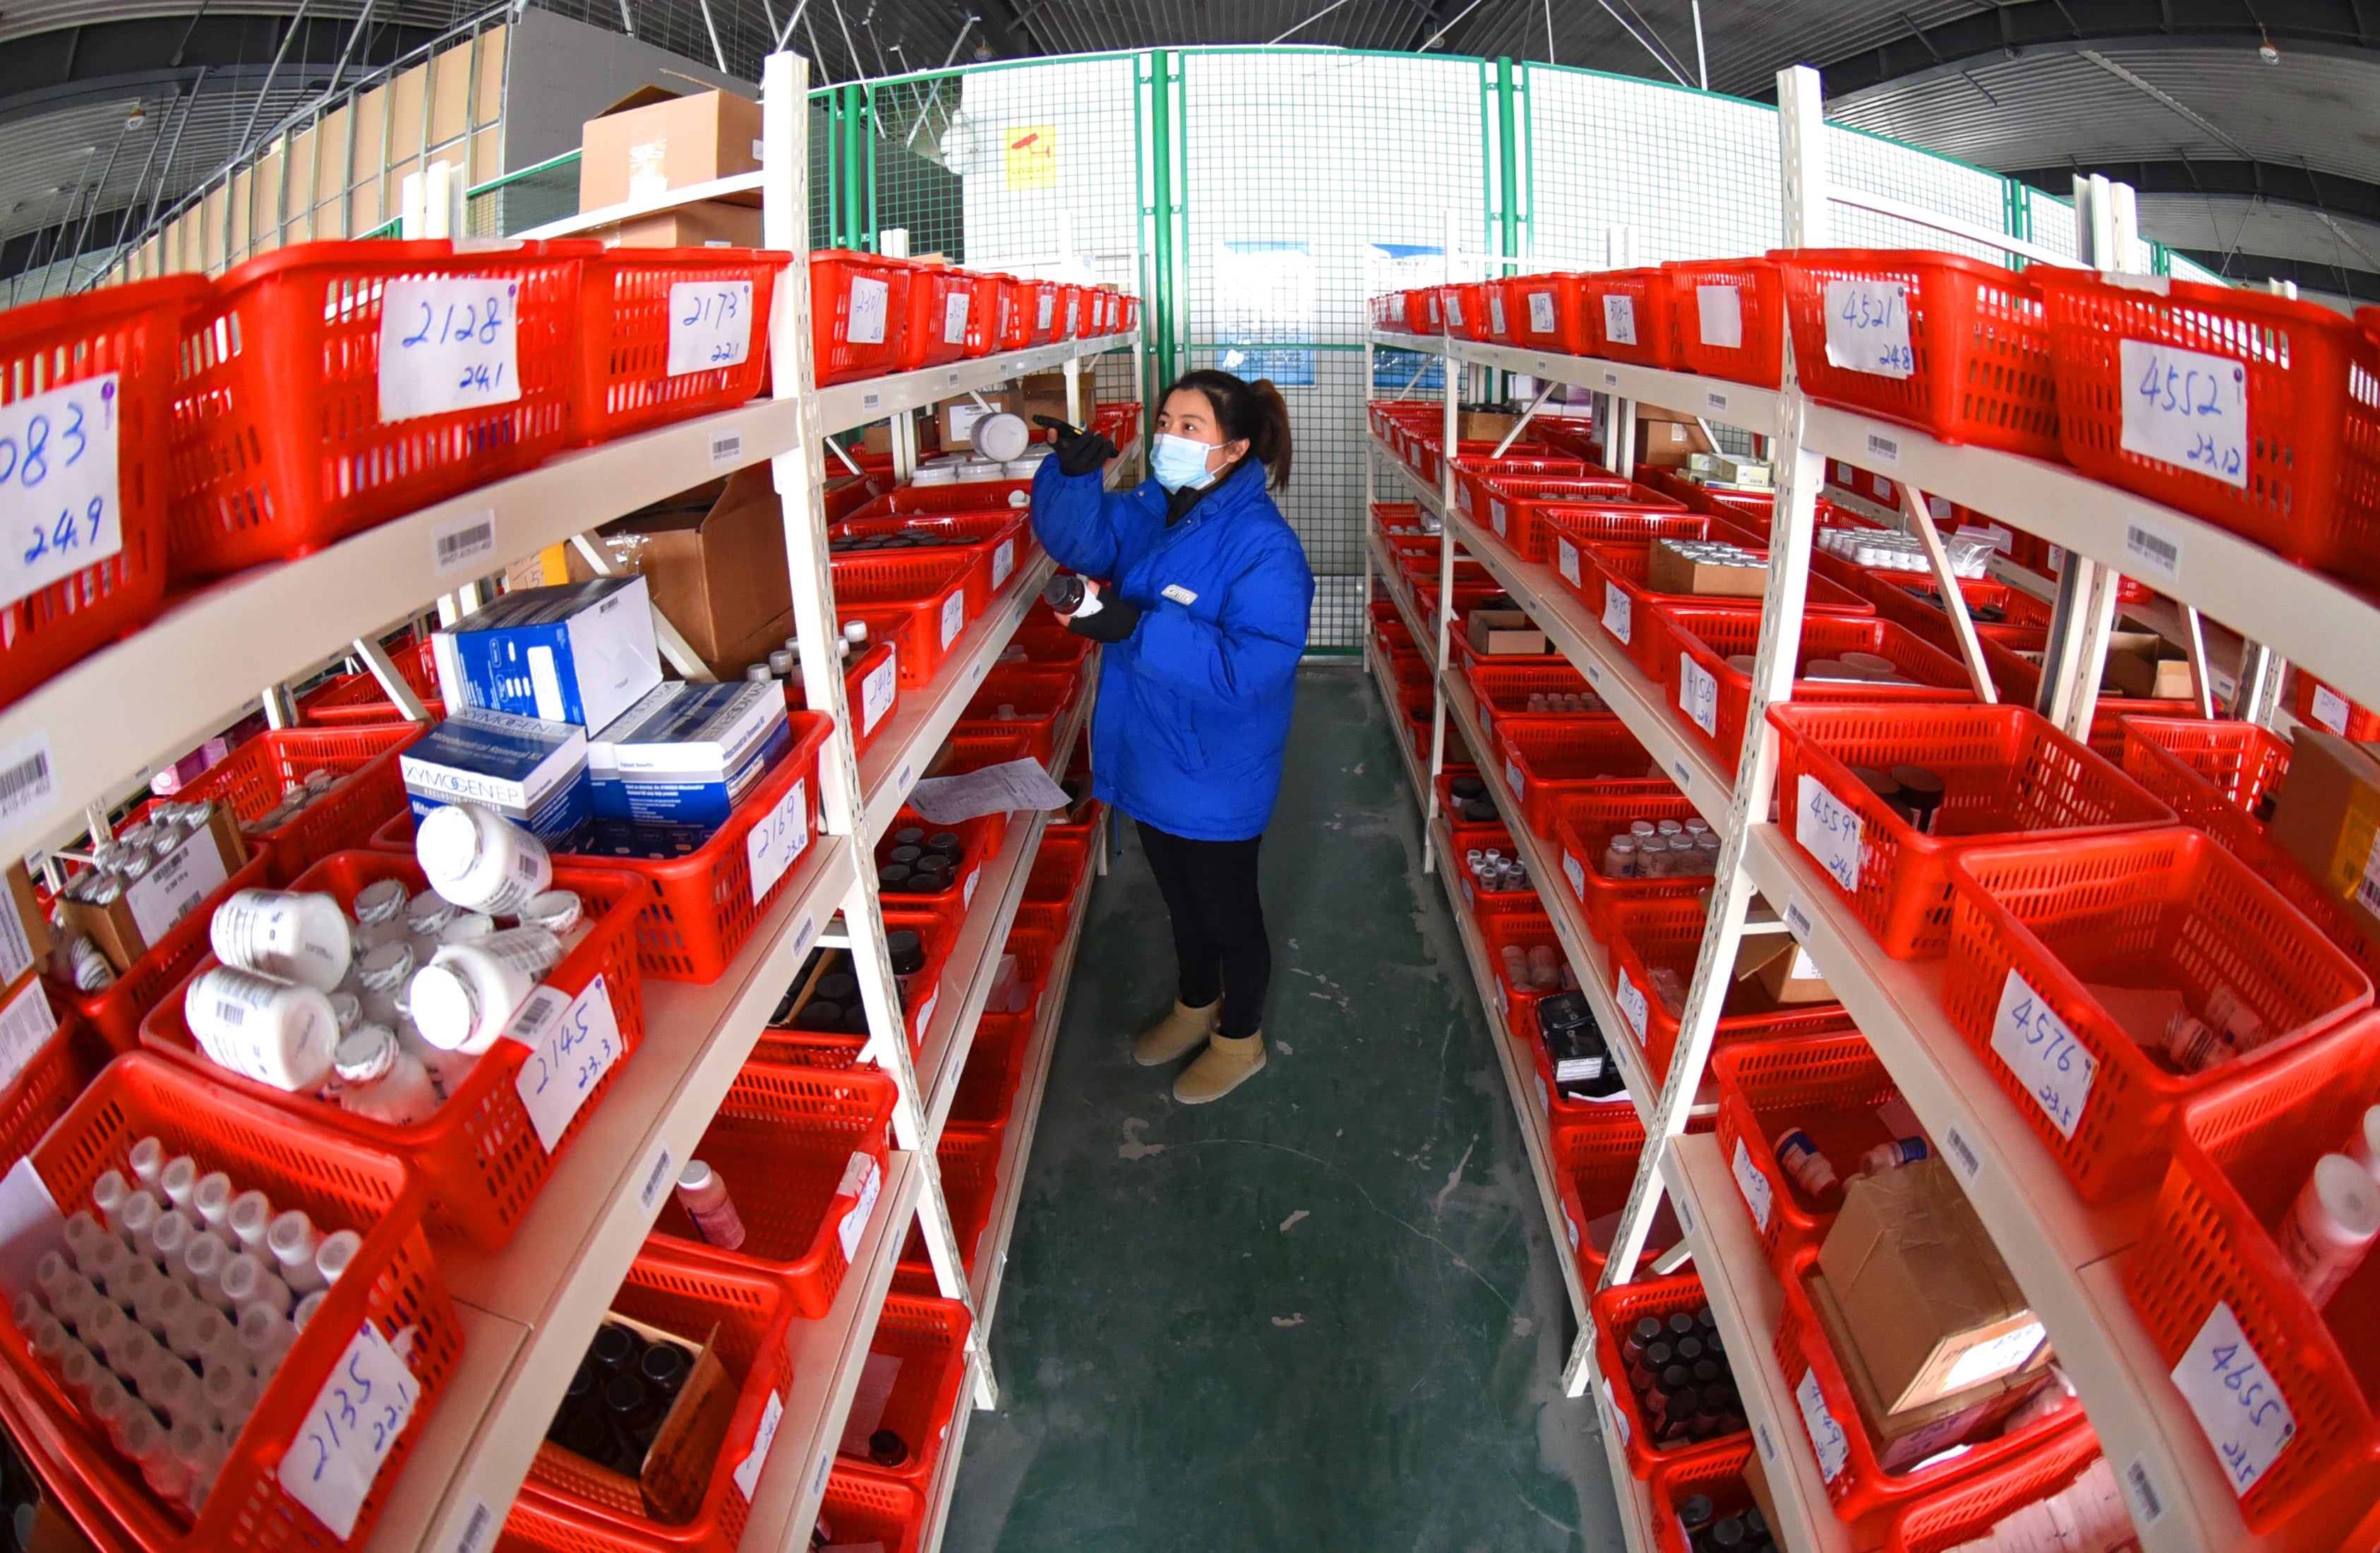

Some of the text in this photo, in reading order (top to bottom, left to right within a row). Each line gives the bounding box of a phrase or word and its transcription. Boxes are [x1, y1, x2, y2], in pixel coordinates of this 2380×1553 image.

[402, 296, 502, 348] 2128
[683, 291, 738, 330] 2173
[1842, 289, 1892, 329] 4521
[2140, 356, 2223, 416] 4552
[757, 795, 794, 858] 2169
[1810, 792, 1850, 841] 4559
[536, 1002, 588, 1095] 2145
[578, 1039, 611, 1089] 23.3
[2012, 998, 2075, 1072] 4576
[373, 1380, 409, 1452] 22.1
[2212, 1344, 2280, 1427] 4655
[308, 1351, 371, 1482] 2135
